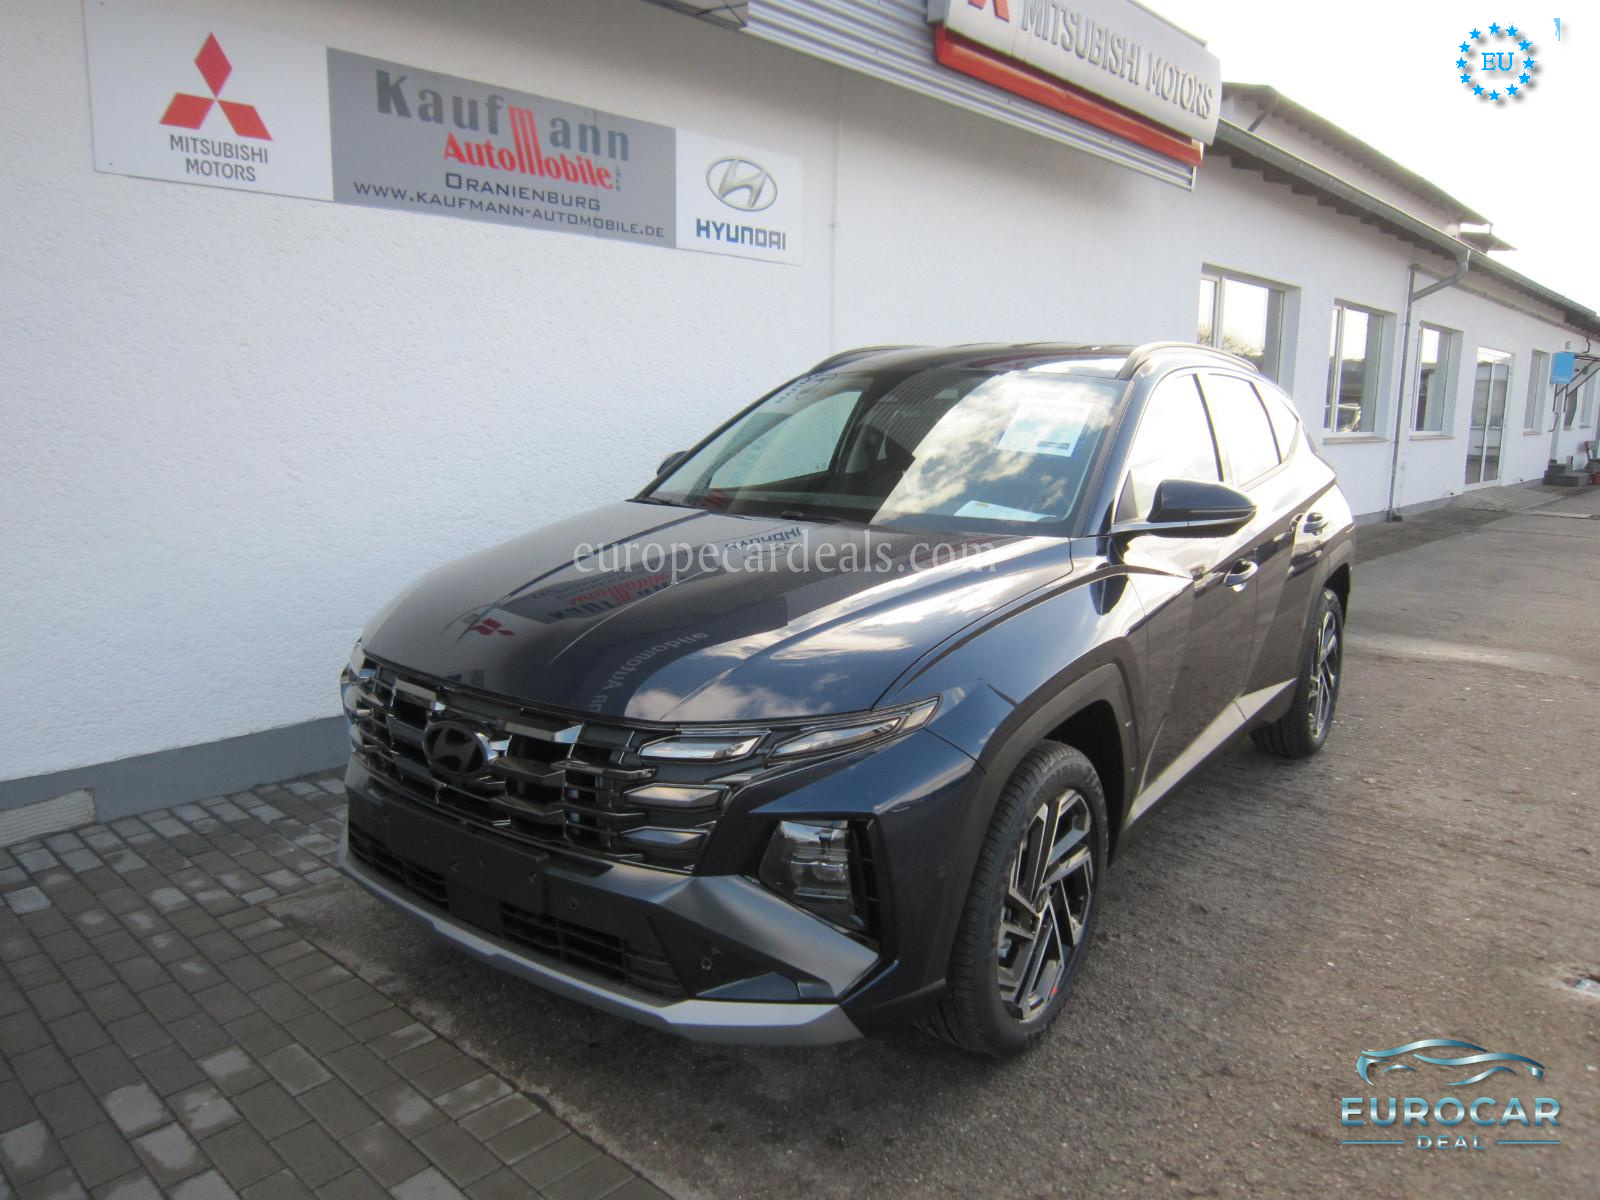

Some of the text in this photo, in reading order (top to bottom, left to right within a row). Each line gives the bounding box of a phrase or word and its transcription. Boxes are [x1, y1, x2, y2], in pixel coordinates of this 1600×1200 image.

[1021, 0, 1213, 119] MITSUBISHI MOTORS
[169, 134, 268, 164] MITSUBISHI
[185, 157, 256, 182] MOTORS
[696, 218, 786, 250] HYUNDAI
